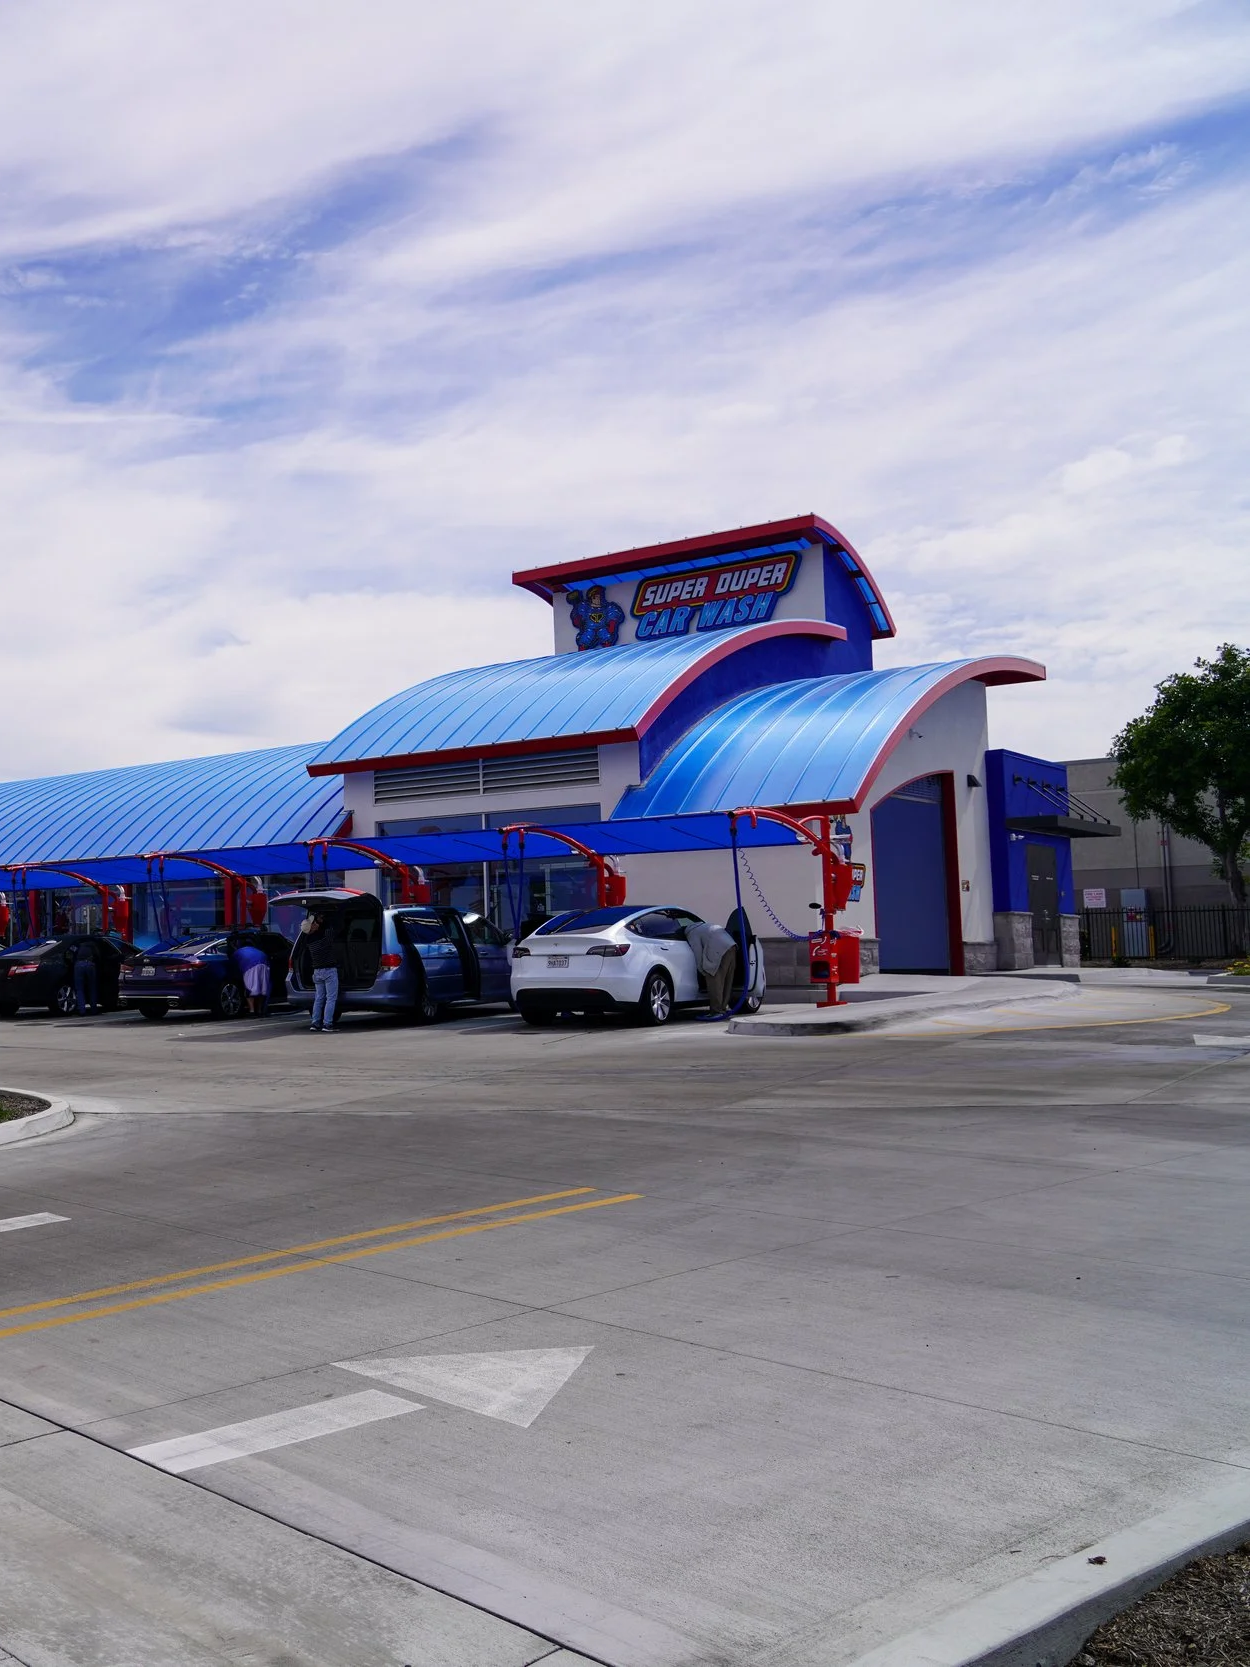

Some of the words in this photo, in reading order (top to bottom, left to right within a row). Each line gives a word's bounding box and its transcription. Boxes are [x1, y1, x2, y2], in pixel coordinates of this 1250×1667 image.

[641, 576, 709, 607] SUPER
[714, 562, 788, 595] DUPER
[637, 605, 691, 638] CAR
[698, 591, 774, 628] WASH
